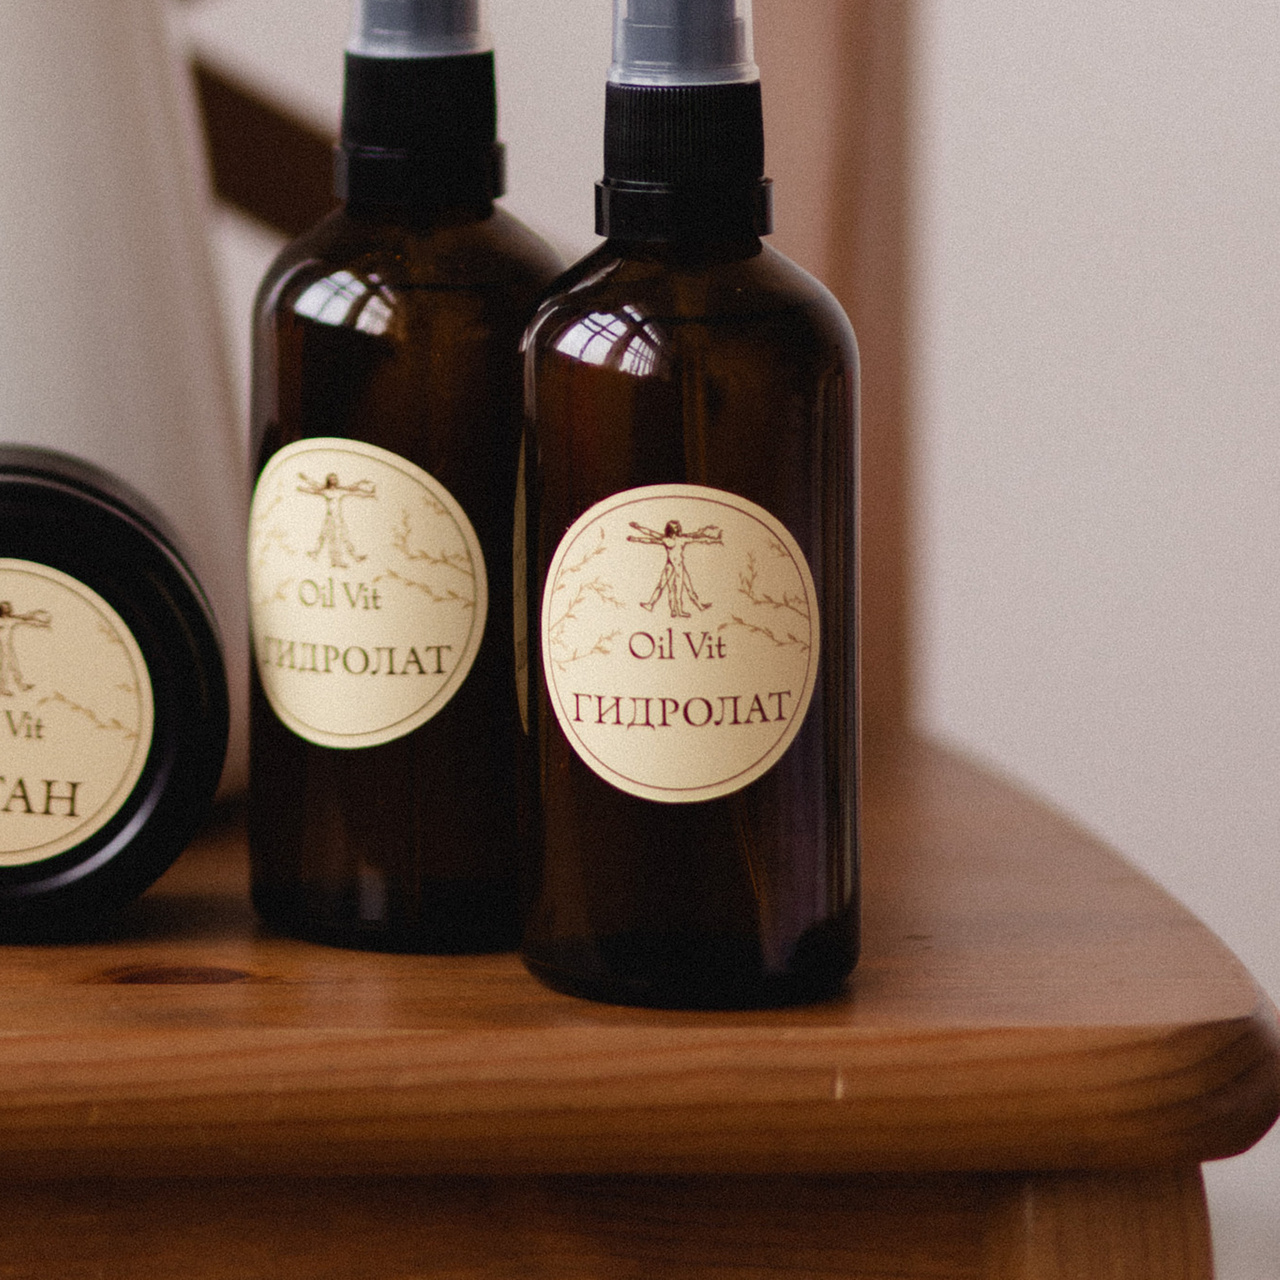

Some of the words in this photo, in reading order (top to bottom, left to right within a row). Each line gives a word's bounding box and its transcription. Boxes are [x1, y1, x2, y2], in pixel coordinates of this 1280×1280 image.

[298, 577, 335, 608] Oil
[341, 581, 382, 611] Vit
[262, 635, 452, 676] ГИДРОЛАТ
[628, 628, 675, 660] Oil
[682, 631, 727, 660] Vit
[4, 708, 47, 740] Vit
[572, 690, 792, 730] ГИДРОЛАТ
